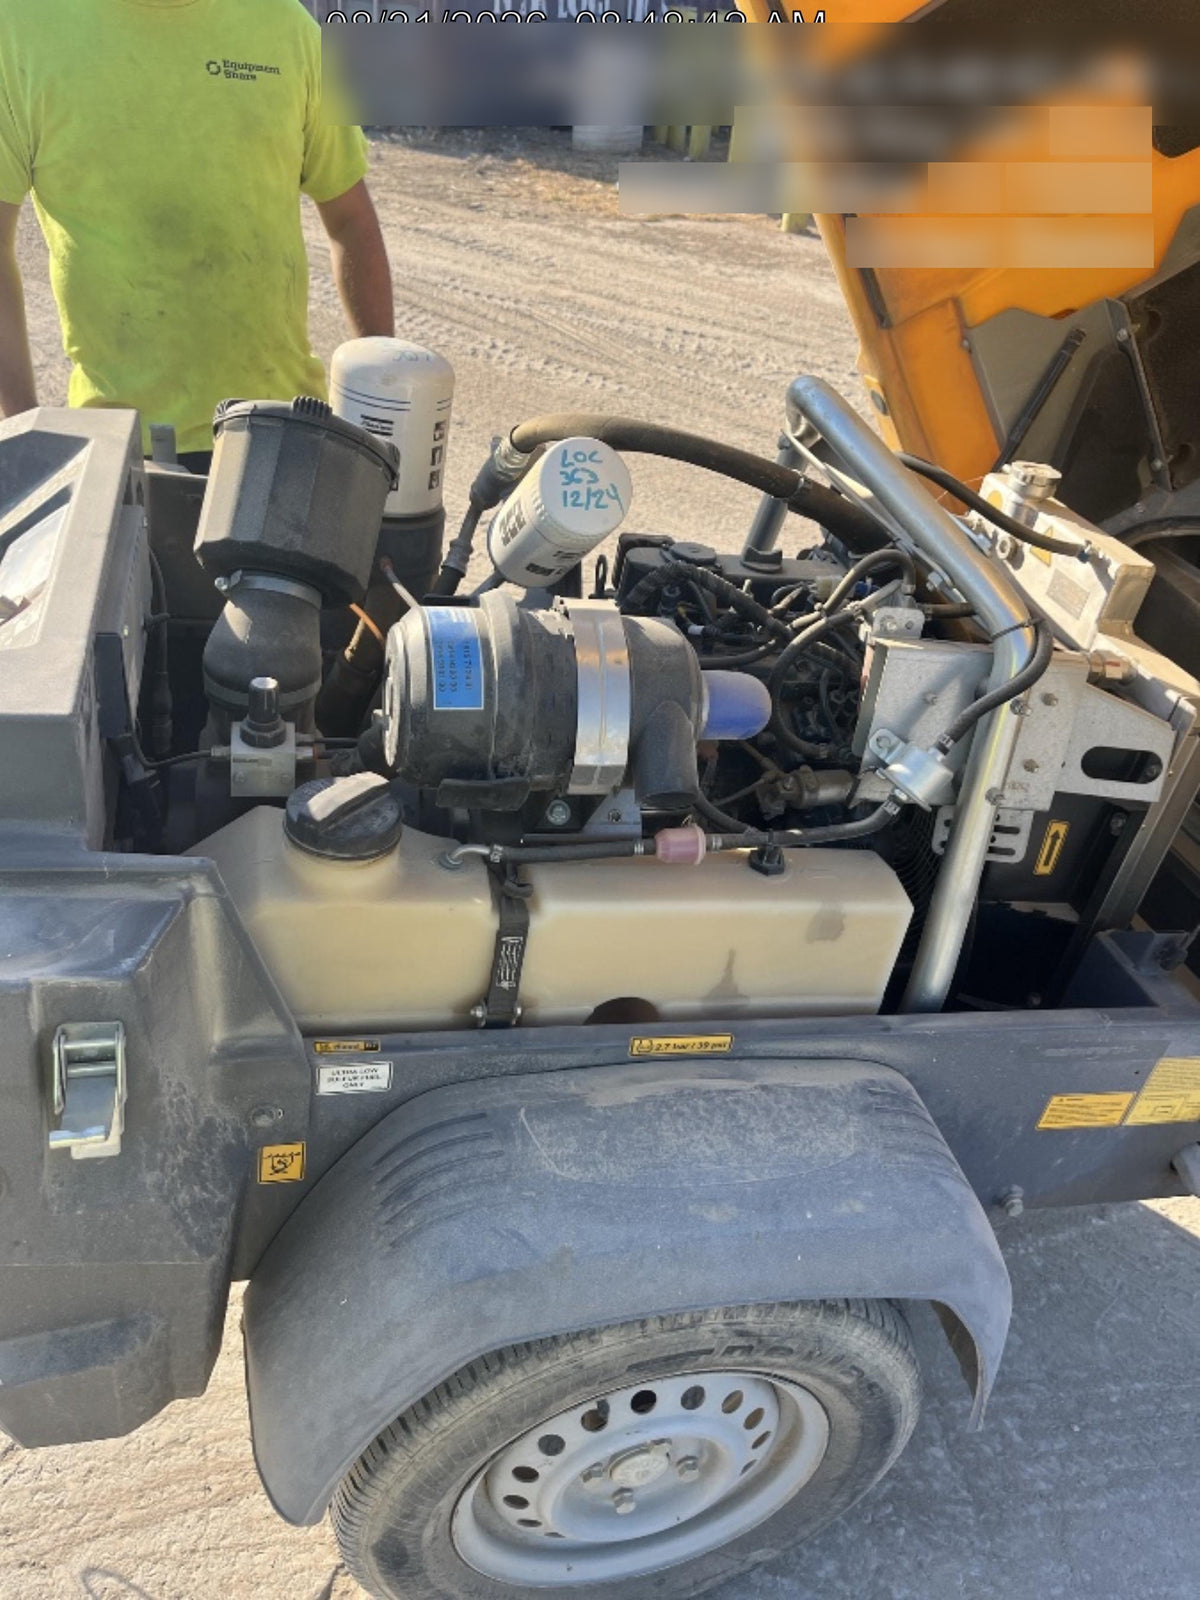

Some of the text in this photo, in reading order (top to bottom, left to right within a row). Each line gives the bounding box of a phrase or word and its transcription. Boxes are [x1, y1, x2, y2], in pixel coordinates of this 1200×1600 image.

[561, 449, 603, 468] LOC
[563, 483, 625, 517] 12/24
[655, 1043, 671, 1052] 2.7
[696, 1041, 710, 1050] 39
